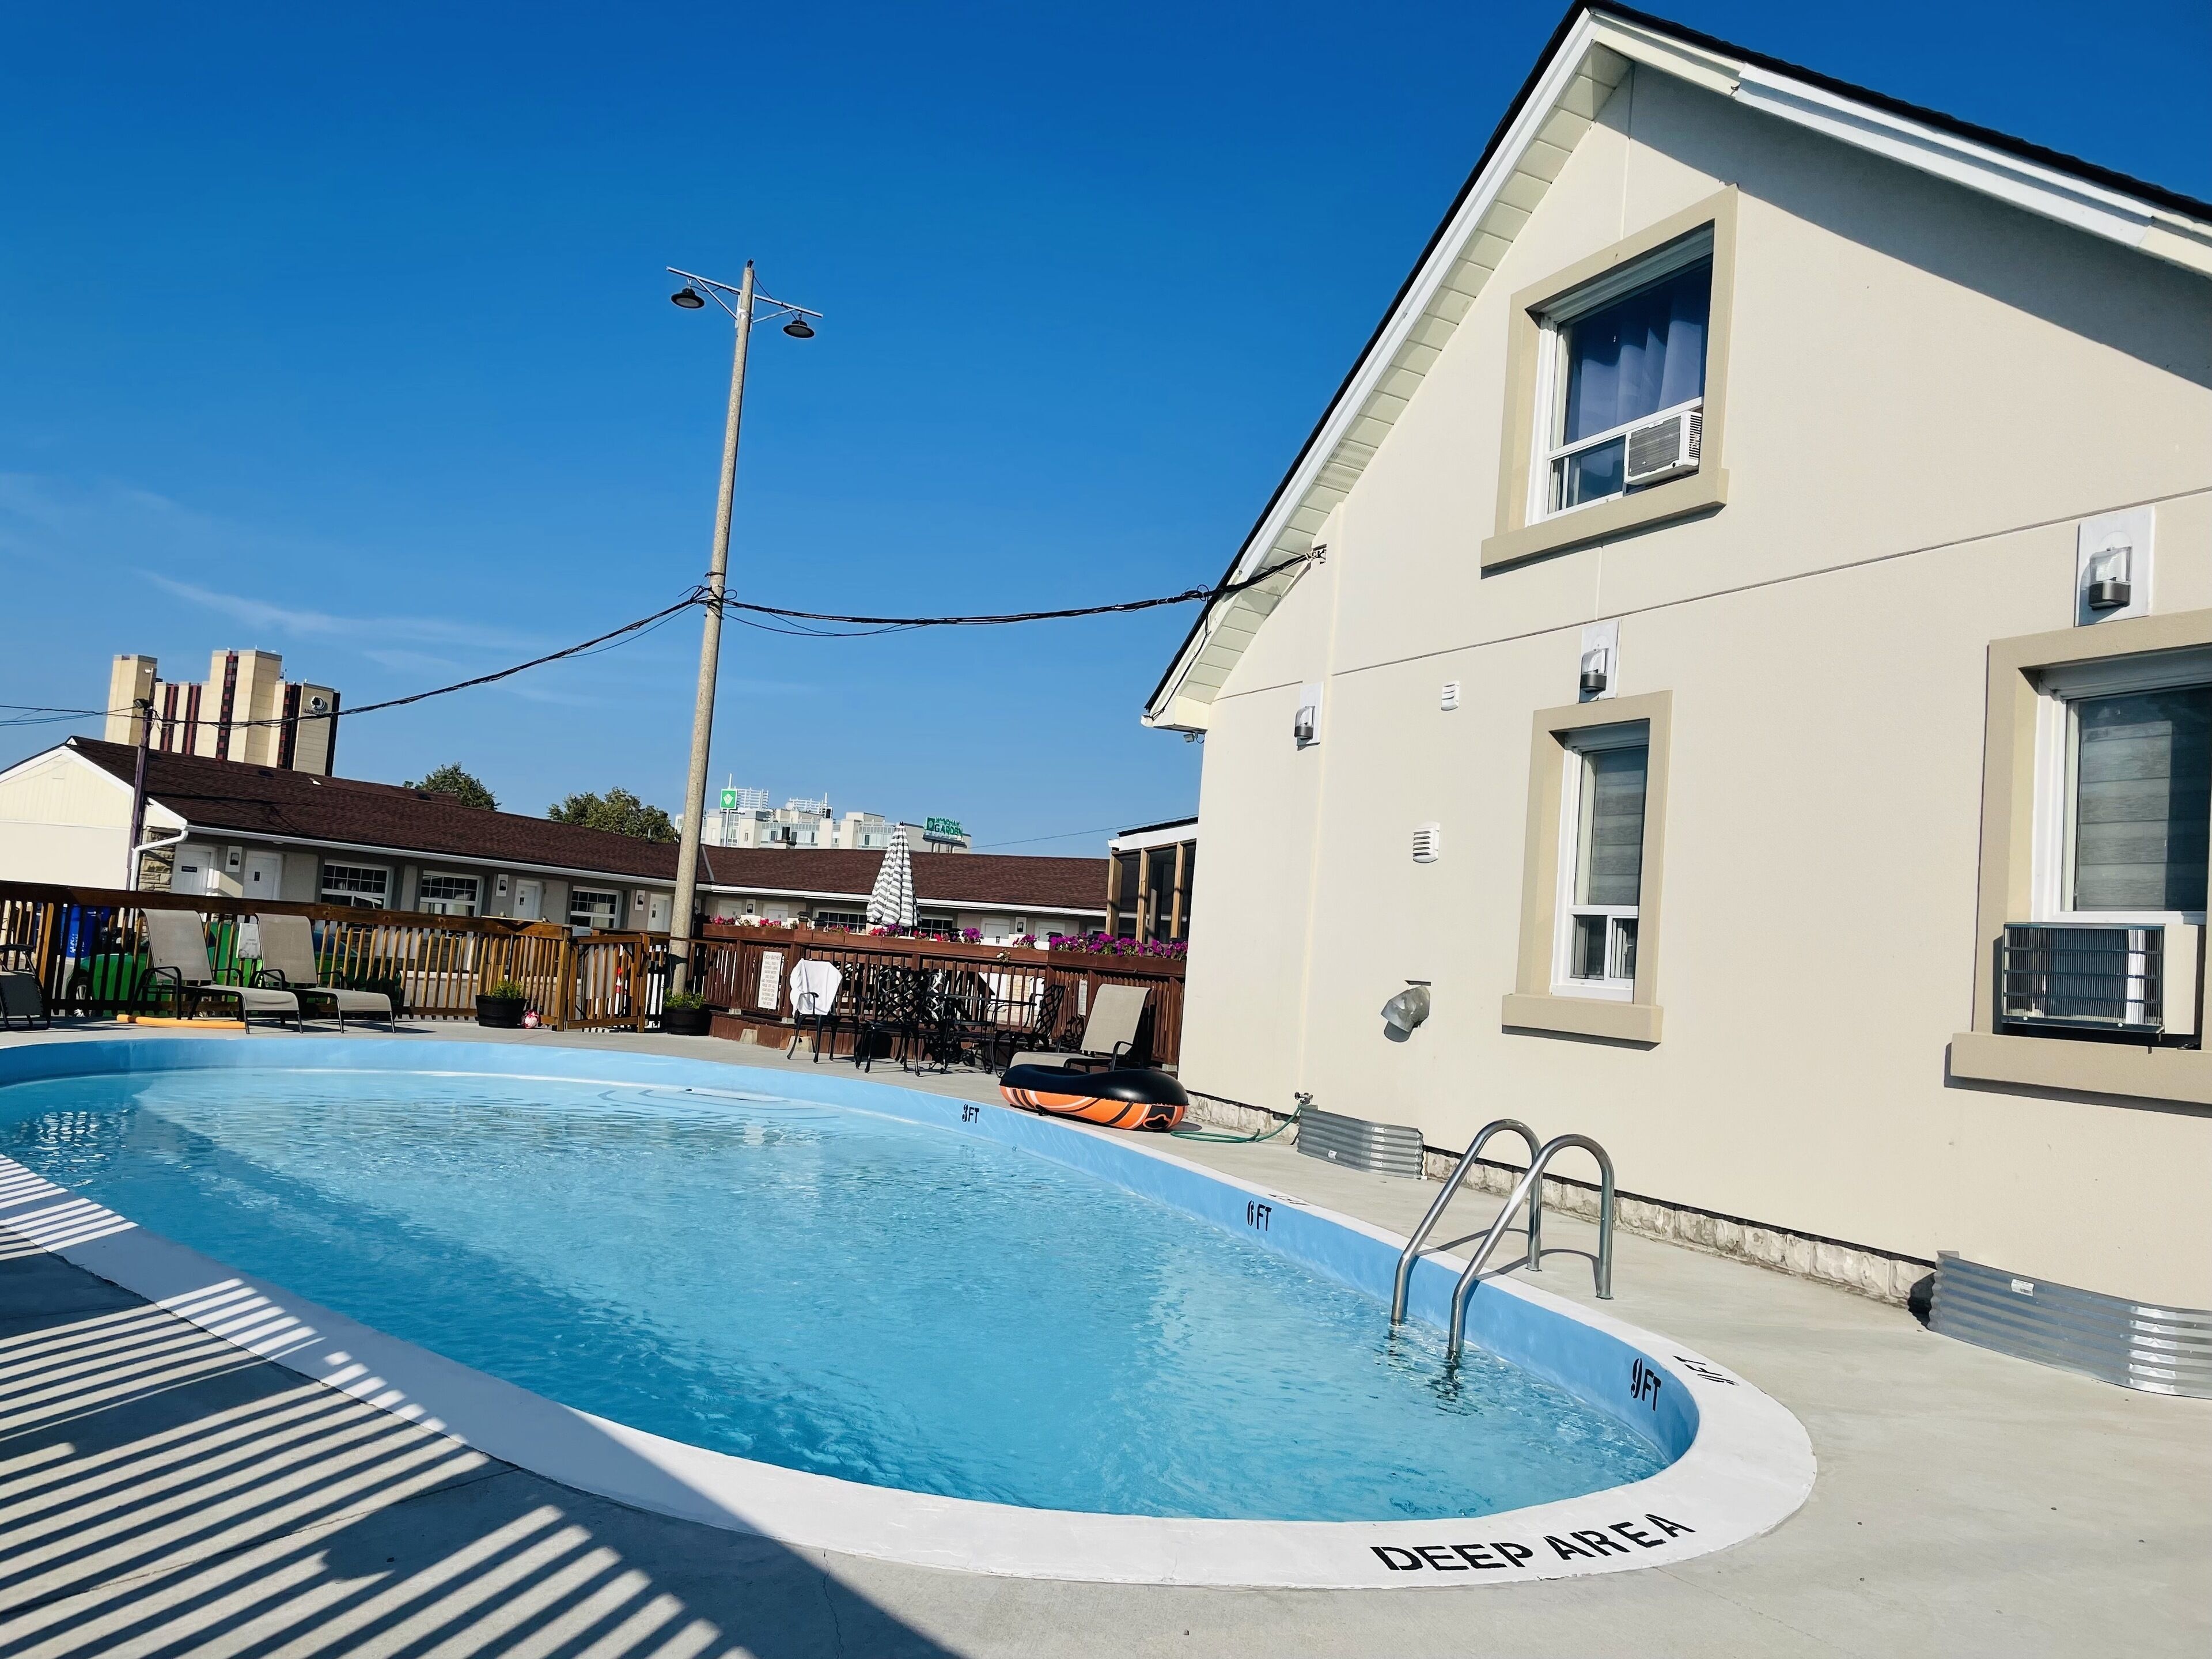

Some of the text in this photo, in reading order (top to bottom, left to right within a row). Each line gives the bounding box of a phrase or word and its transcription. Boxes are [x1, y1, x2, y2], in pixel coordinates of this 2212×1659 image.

[934, 824, 963, 836] GARDEN
[1370, 1513, 1696, 1571] DEEP AREA
